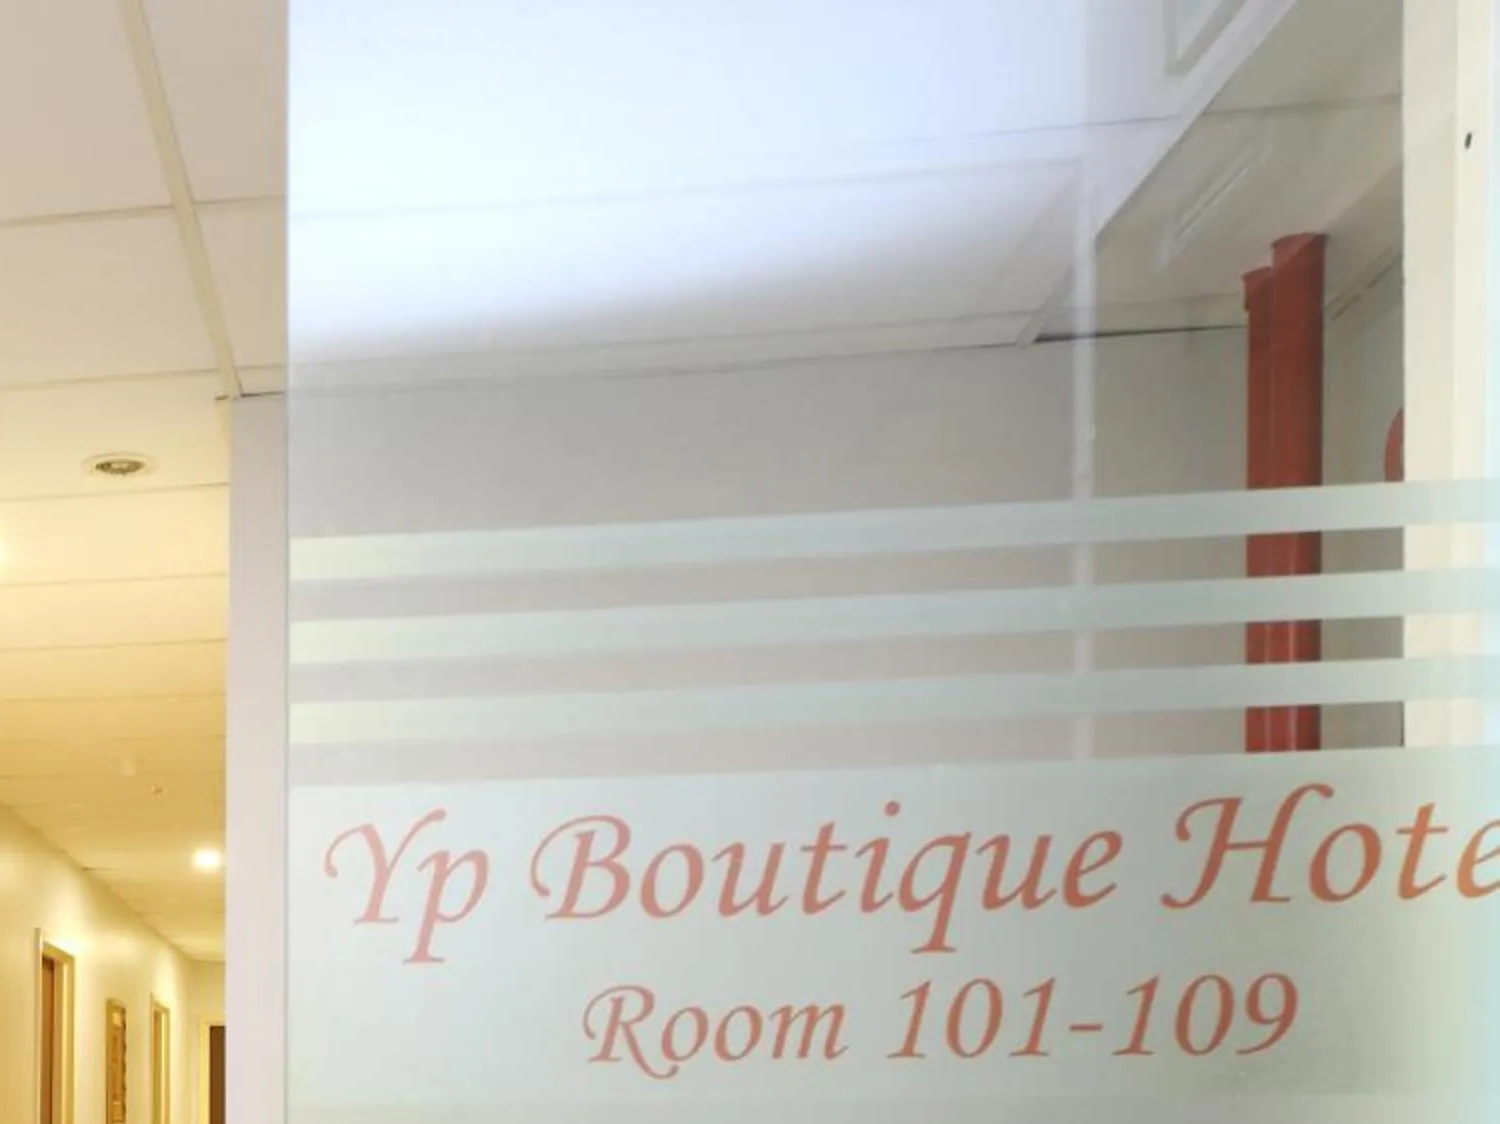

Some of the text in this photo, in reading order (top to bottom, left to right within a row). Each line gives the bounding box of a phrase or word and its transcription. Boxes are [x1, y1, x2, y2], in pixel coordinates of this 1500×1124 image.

[322, 783, 1500, 966] Yp Boutique Hote
[581, 972, 1300, 1081] Room 101-109
